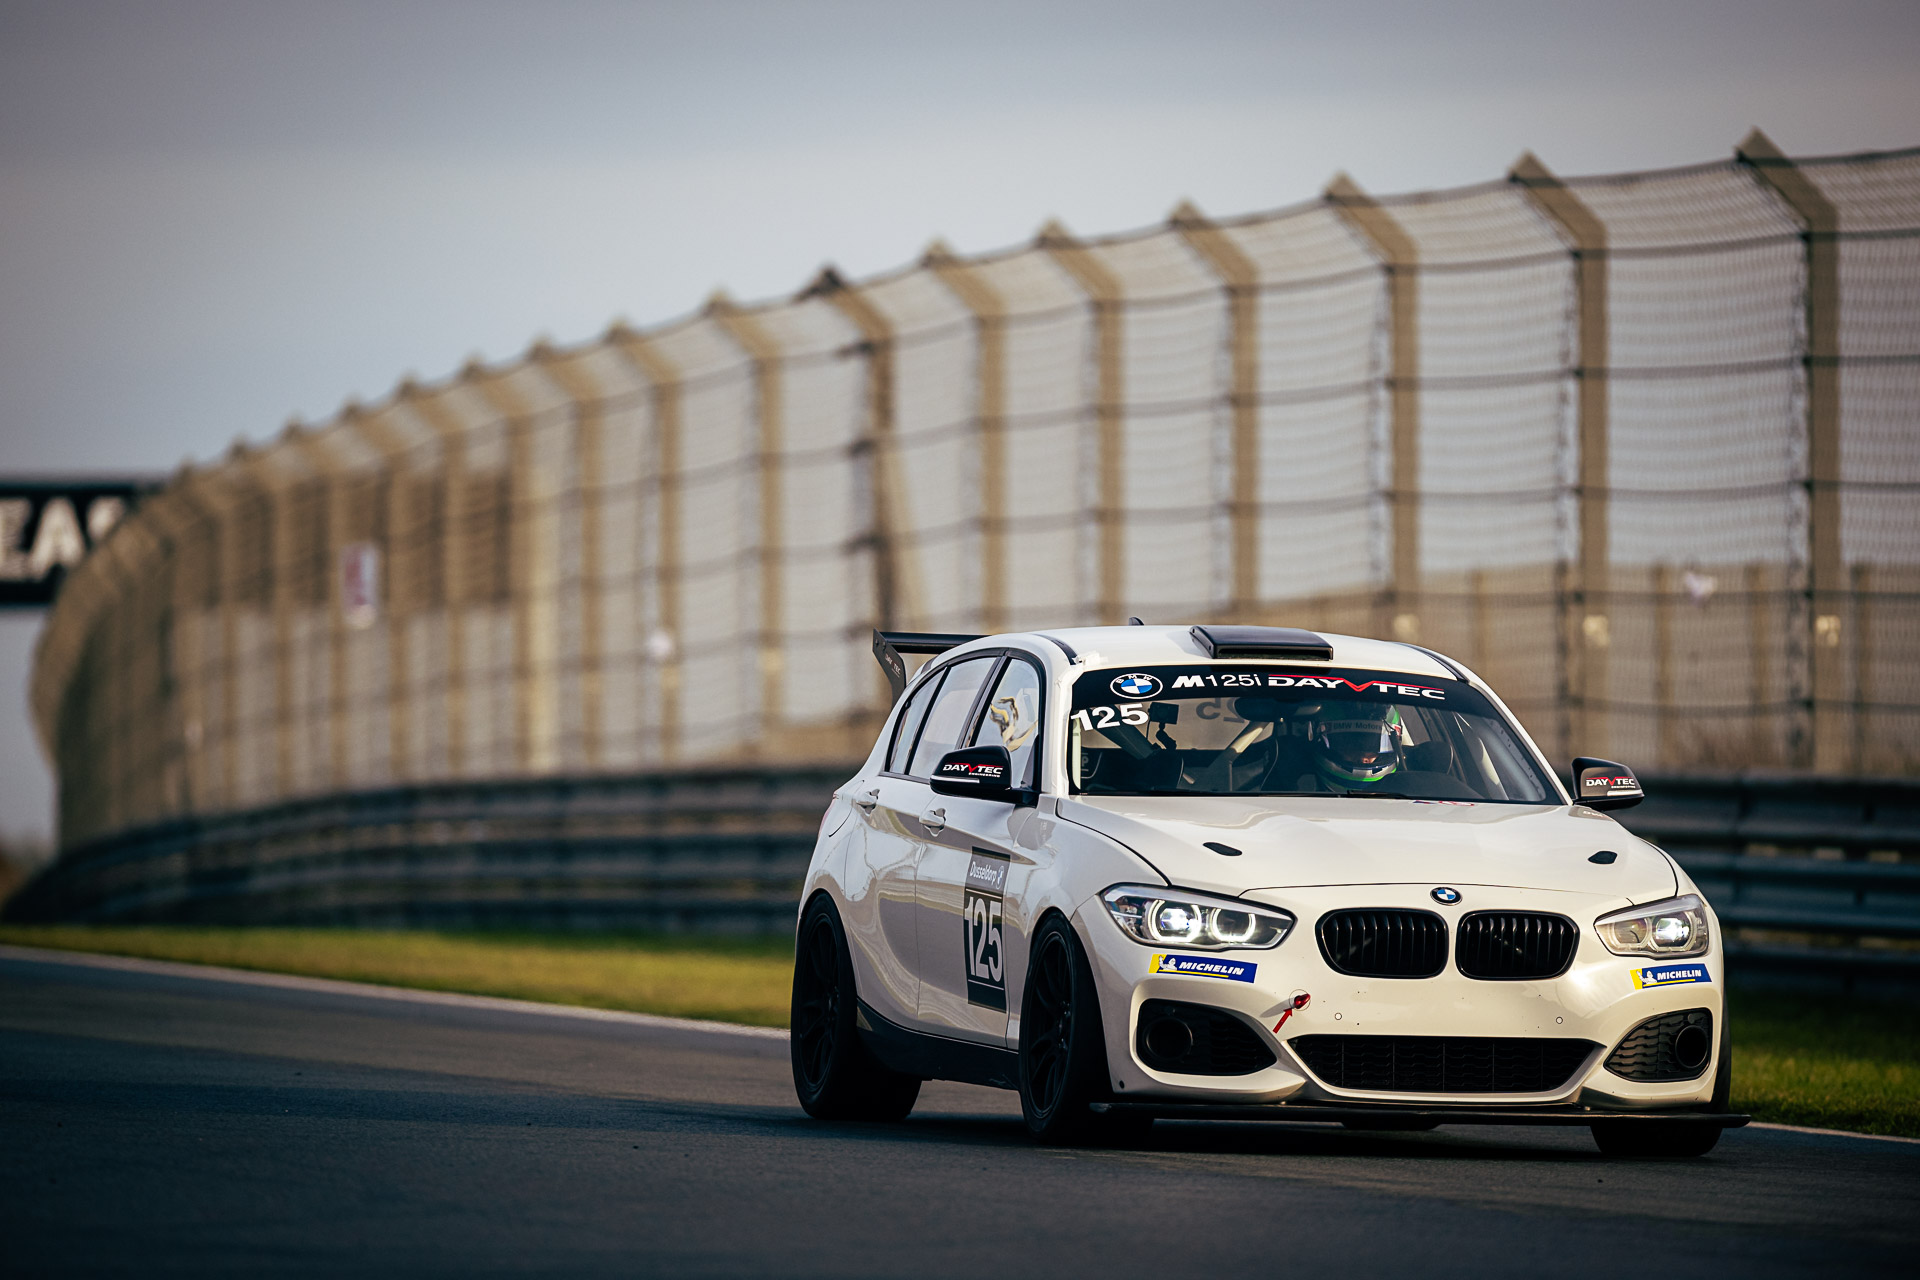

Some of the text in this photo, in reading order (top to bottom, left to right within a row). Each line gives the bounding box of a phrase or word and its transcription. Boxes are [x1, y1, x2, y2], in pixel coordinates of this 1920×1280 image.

[1268, 674, 1446, 700] DAYVTEC
[1070, 703, 1149, 732] 125
[970, 861, 998, 886] Dusseldorp
[964, 896, 1003, 982] 125
[1179, 961, 1245, 976] MICHELIN
[1656, 969, 1702, 981] MICHELIN
